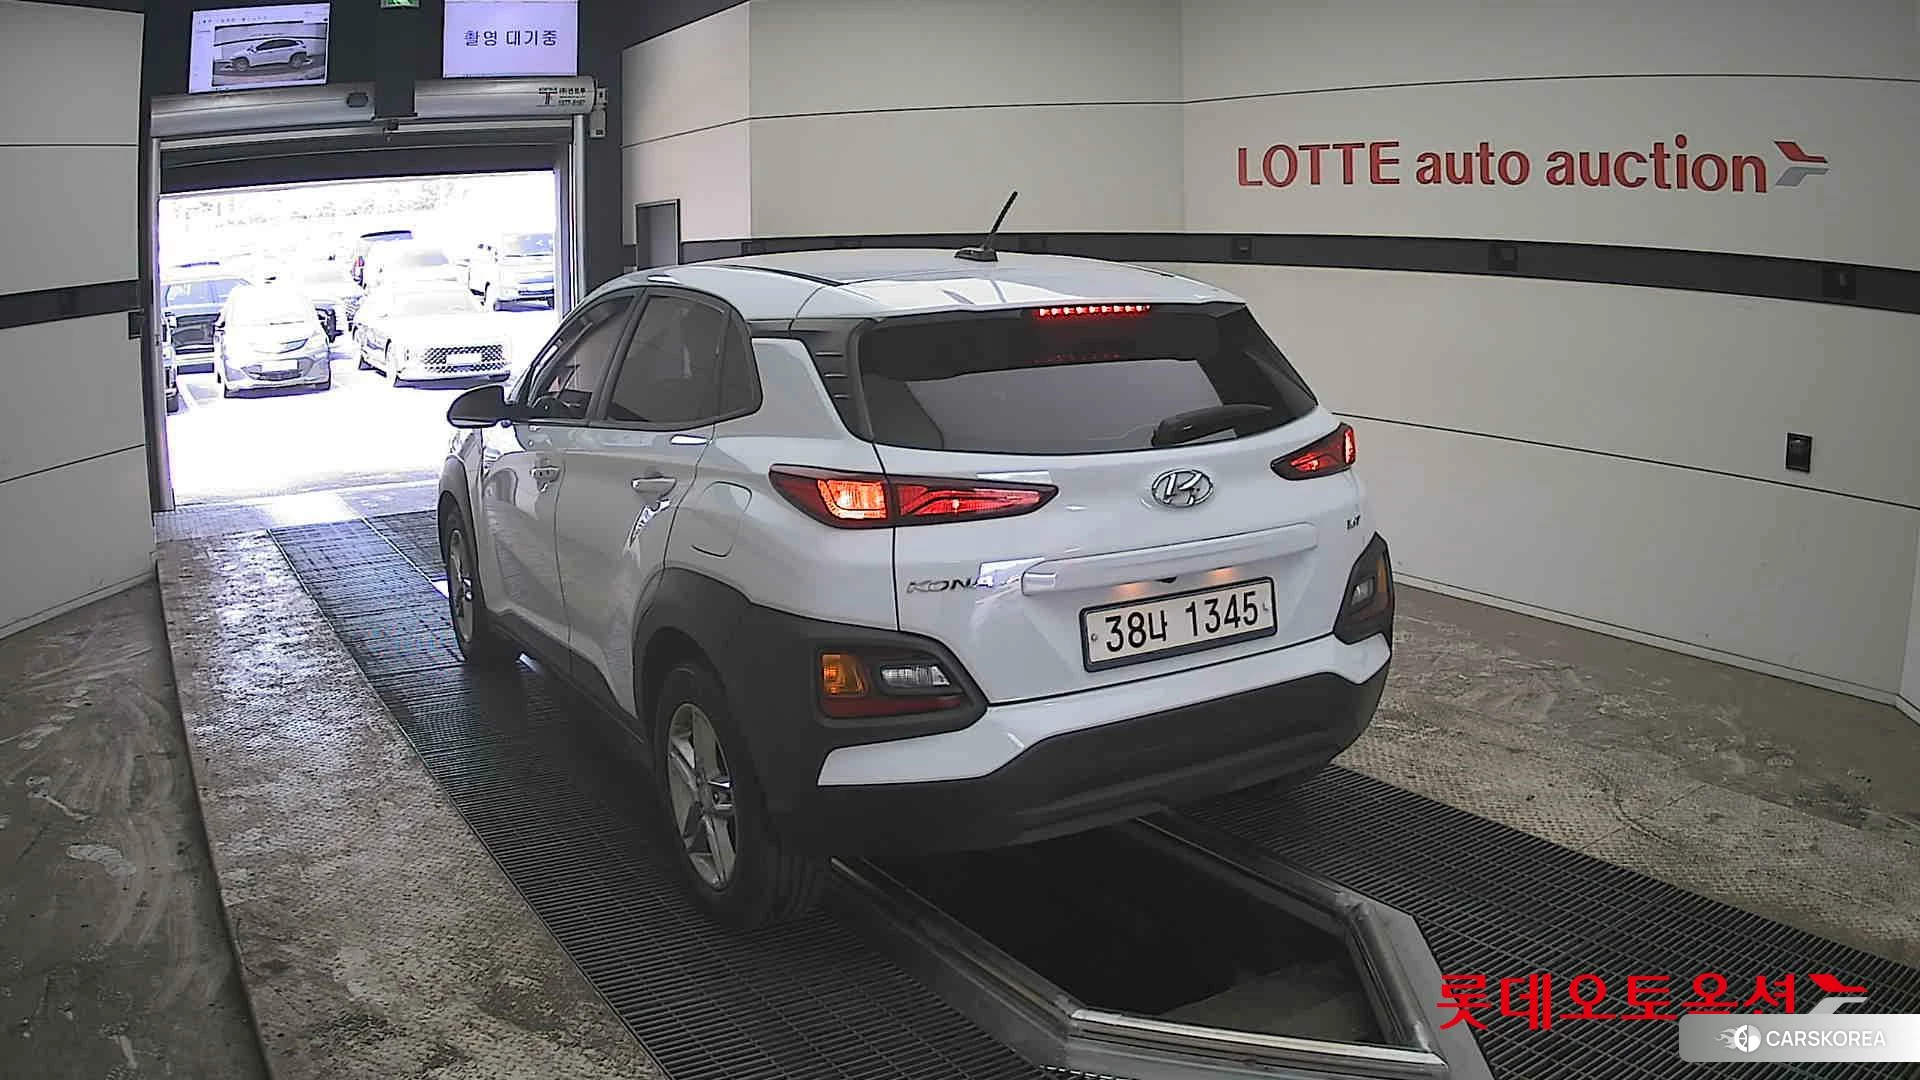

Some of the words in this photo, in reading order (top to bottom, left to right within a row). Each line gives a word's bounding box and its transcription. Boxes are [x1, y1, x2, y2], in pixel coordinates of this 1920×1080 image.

[506, 30, 557, 46] 대기중
[1237, 141, 1400, 187] LOTTE
[1415, 141, 1530, 186] auto
[1546, 134, 1768, 194] auction
[1105, 610, 1168, 652] 38나
[1185, 591, 1258, 637] 1345
